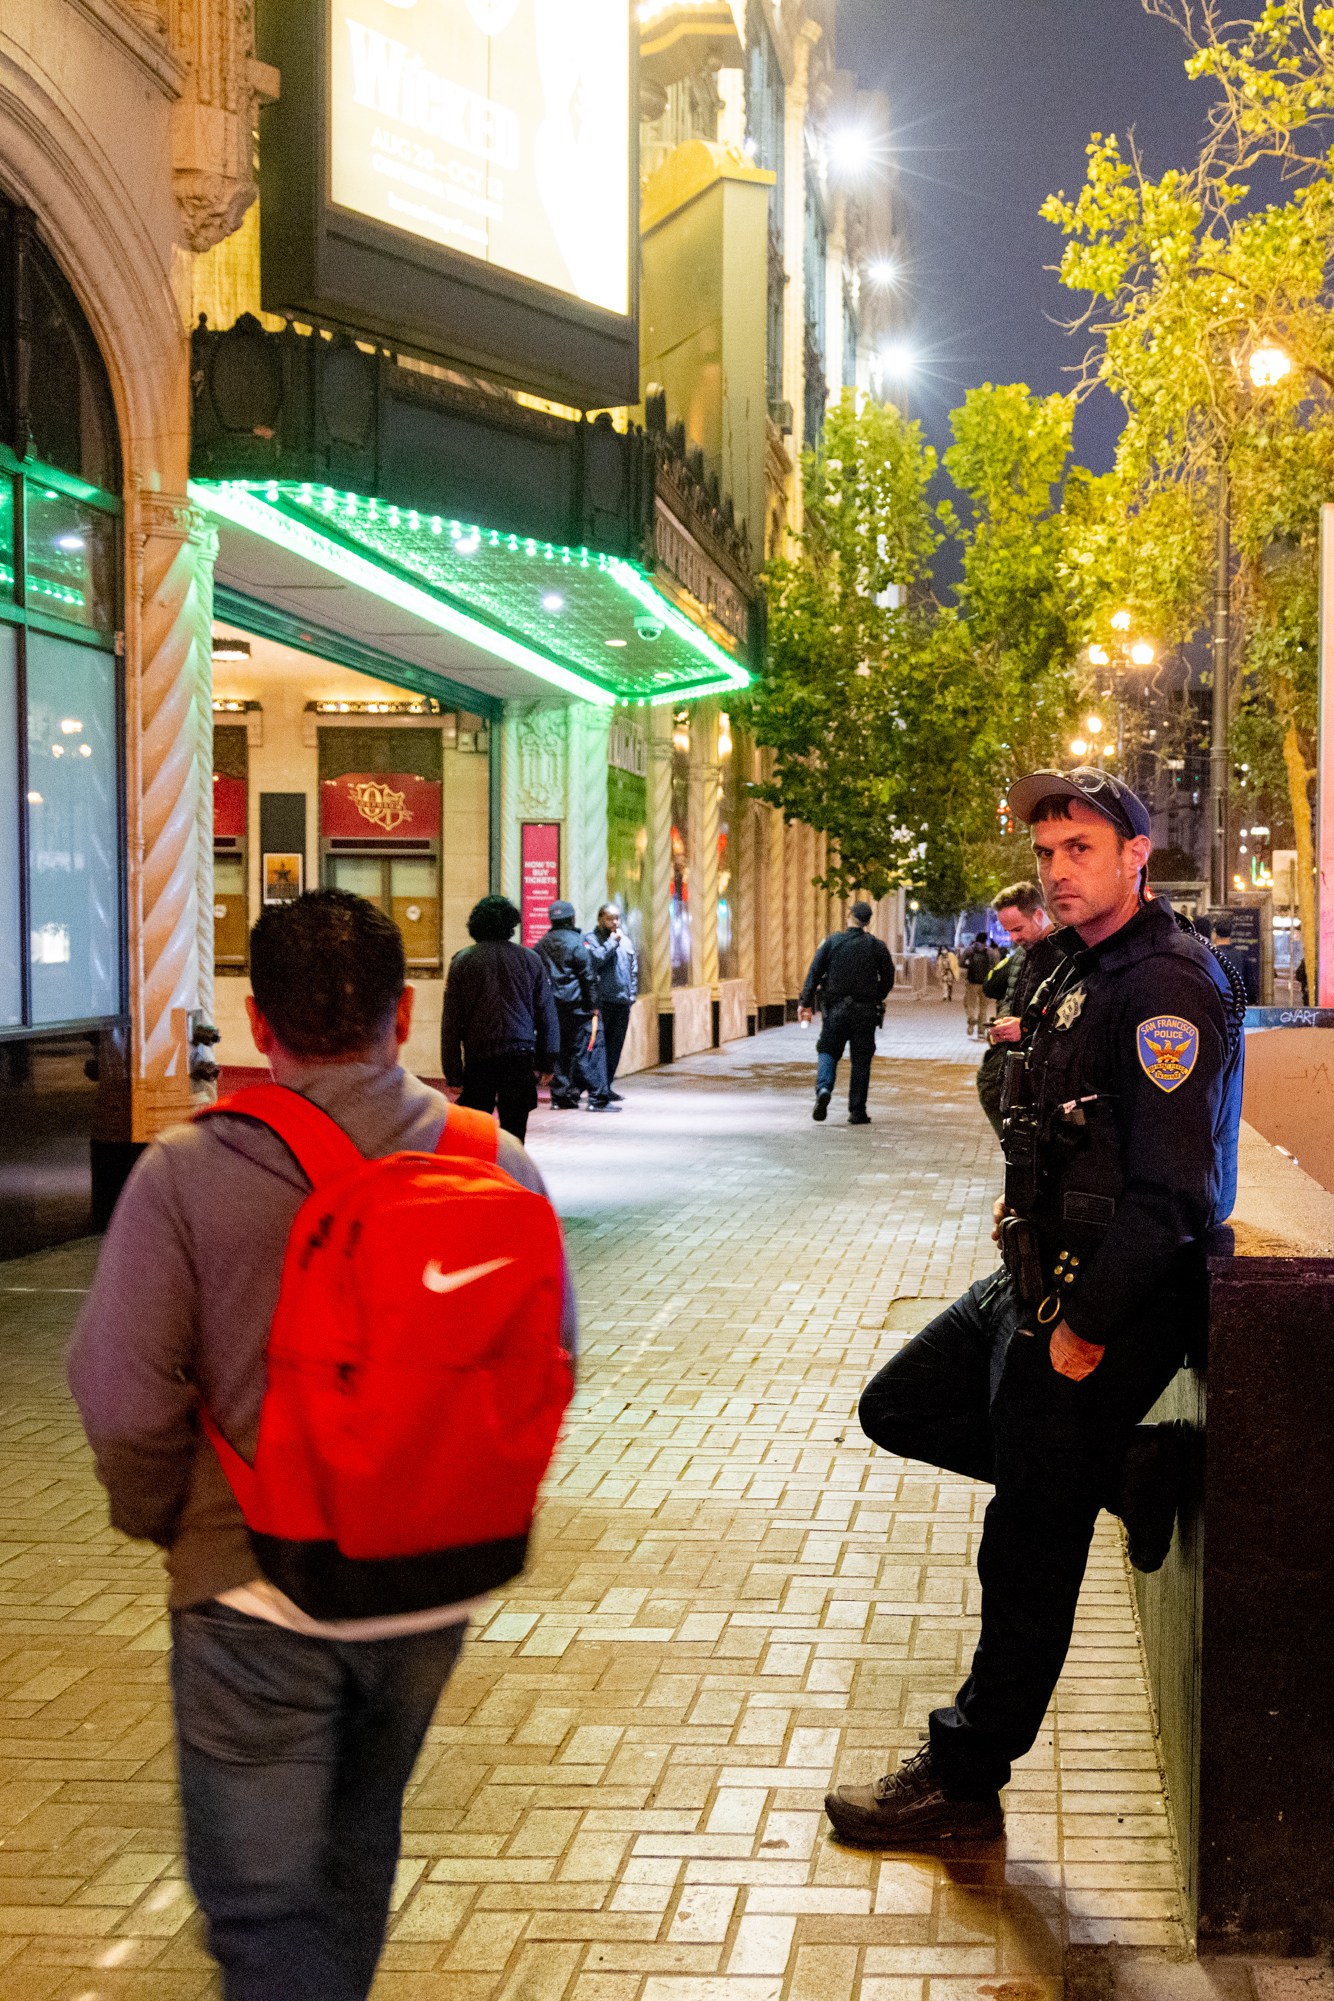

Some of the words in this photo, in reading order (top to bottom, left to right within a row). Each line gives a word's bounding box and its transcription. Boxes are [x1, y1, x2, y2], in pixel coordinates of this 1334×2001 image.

[370, 127, 411, 161] AUG
[524, 876, 557, 884] TICKETS
[1141, 1022, 1156, 1035] SAN
[1157, 1019, 1195, 1037] FRANCISCO
[1154, 1030, 1183, 1039] POLICE
